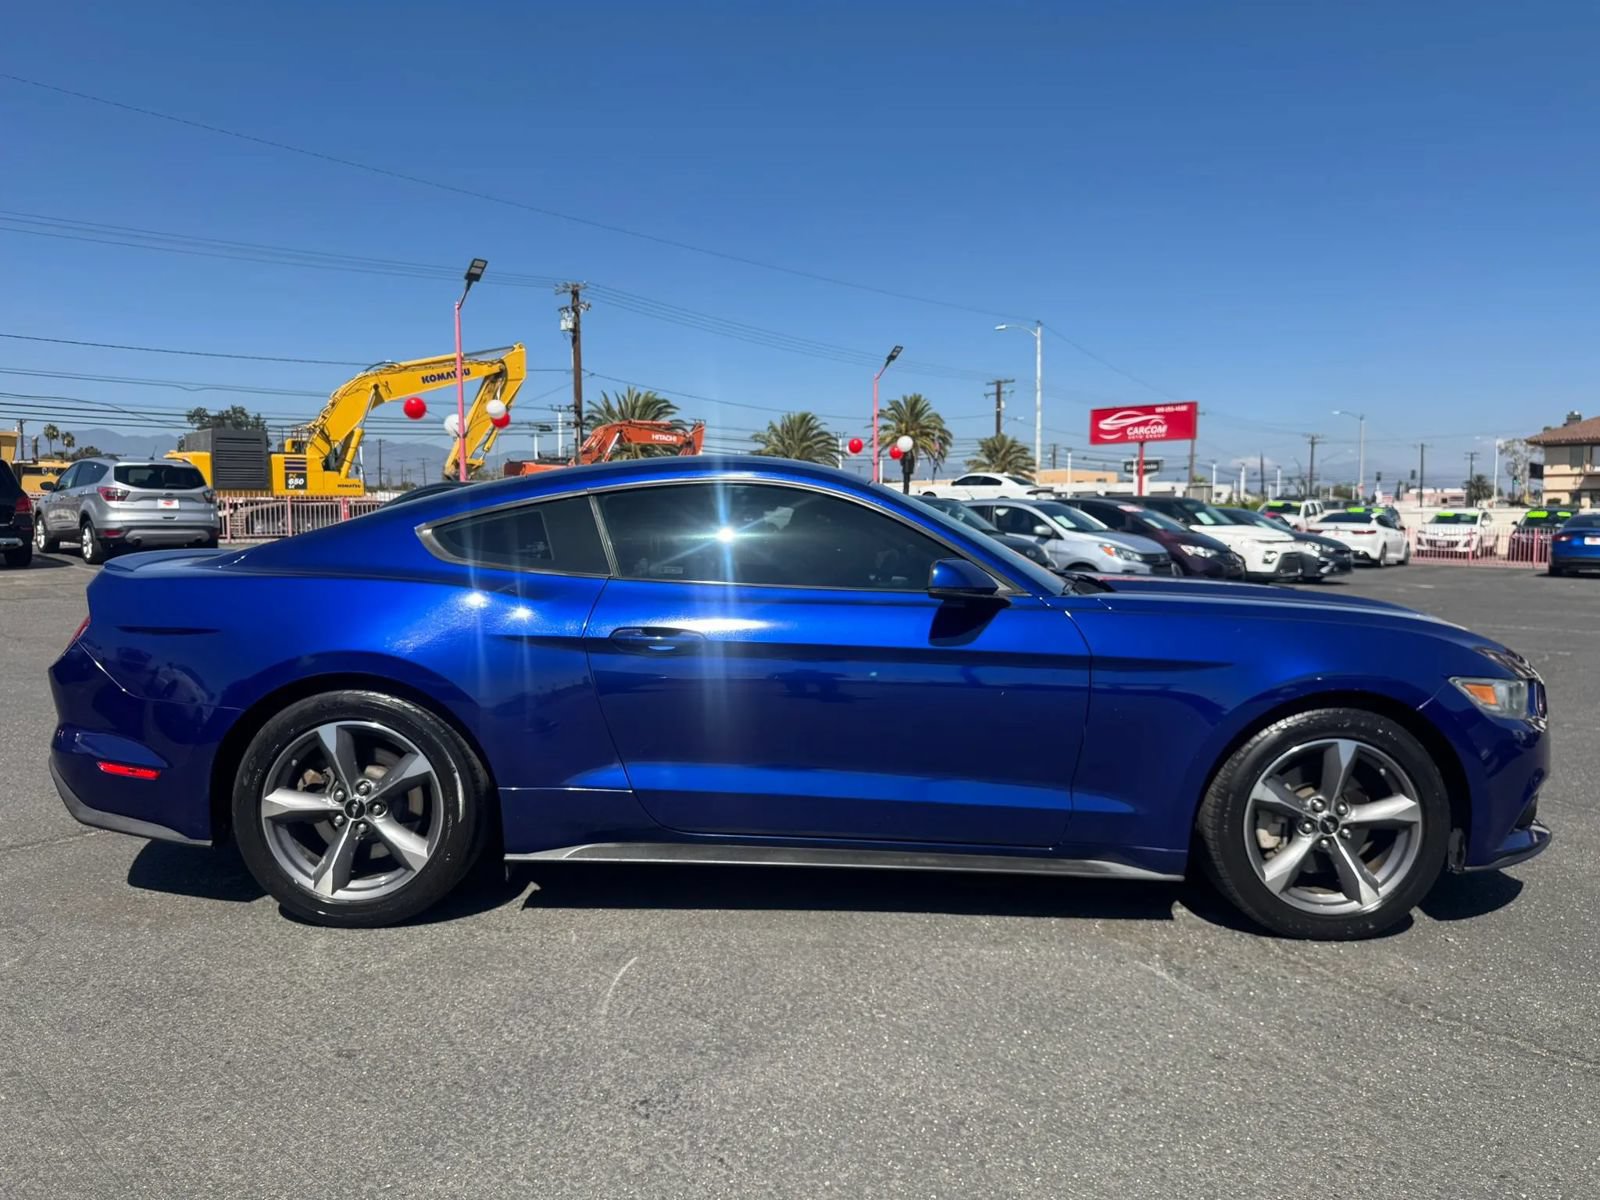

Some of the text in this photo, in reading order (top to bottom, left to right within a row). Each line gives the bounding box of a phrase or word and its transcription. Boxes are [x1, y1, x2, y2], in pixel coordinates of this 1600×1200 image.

[421, 368, 471, 384] KOMATU
[1126, 425, 1168, 436] CARCOM
[651, 433, 678, 442] HITACHI
